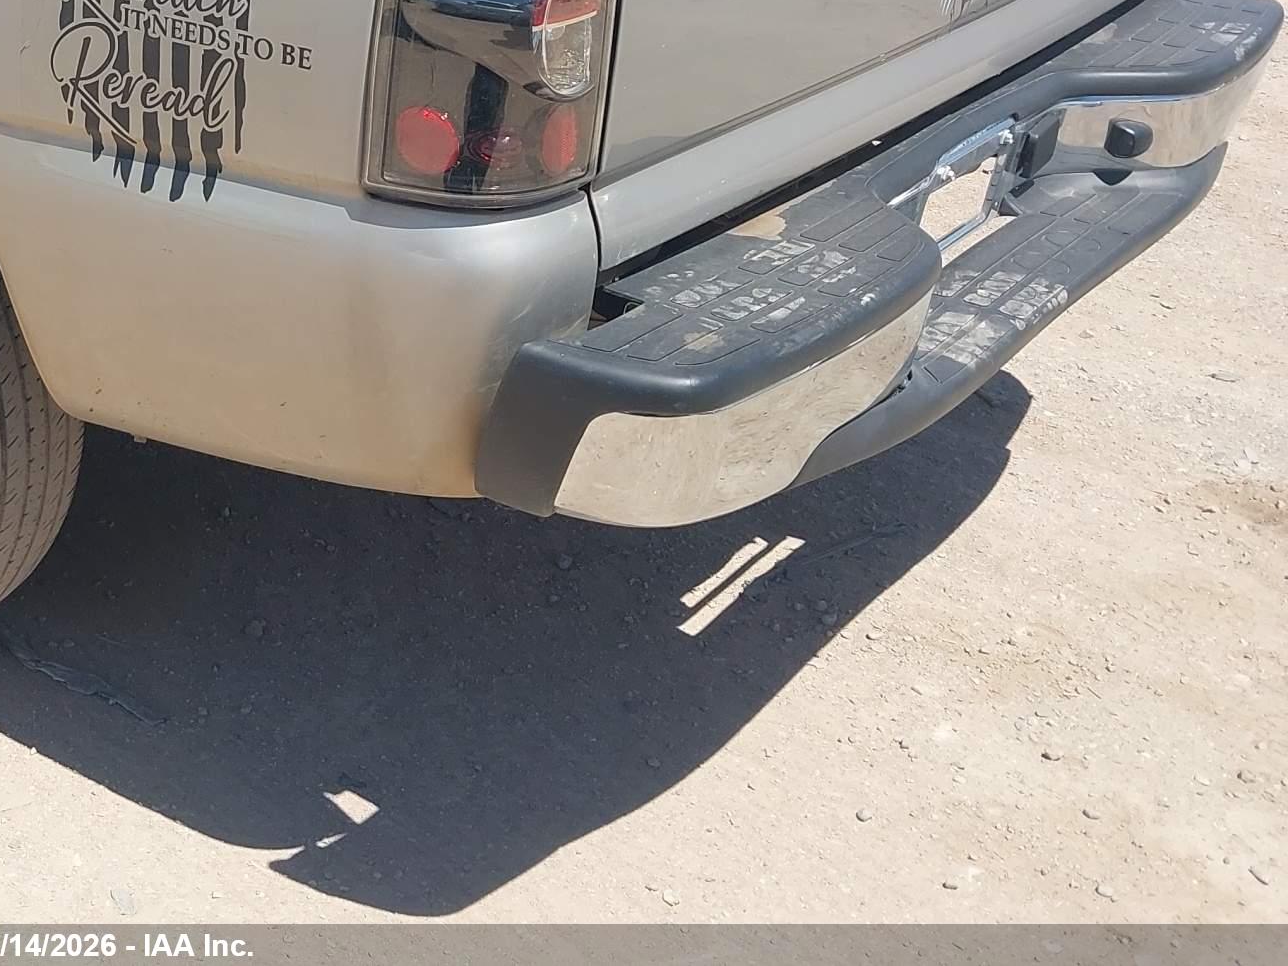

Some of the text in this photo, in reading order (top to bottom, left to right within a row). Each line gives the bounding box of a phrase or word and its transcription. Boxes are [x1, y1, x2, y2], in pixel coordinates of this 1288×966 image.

[51, 22, 235, 144] Reread
[122, 7, 313, 70] IT NEEDS TO BE
